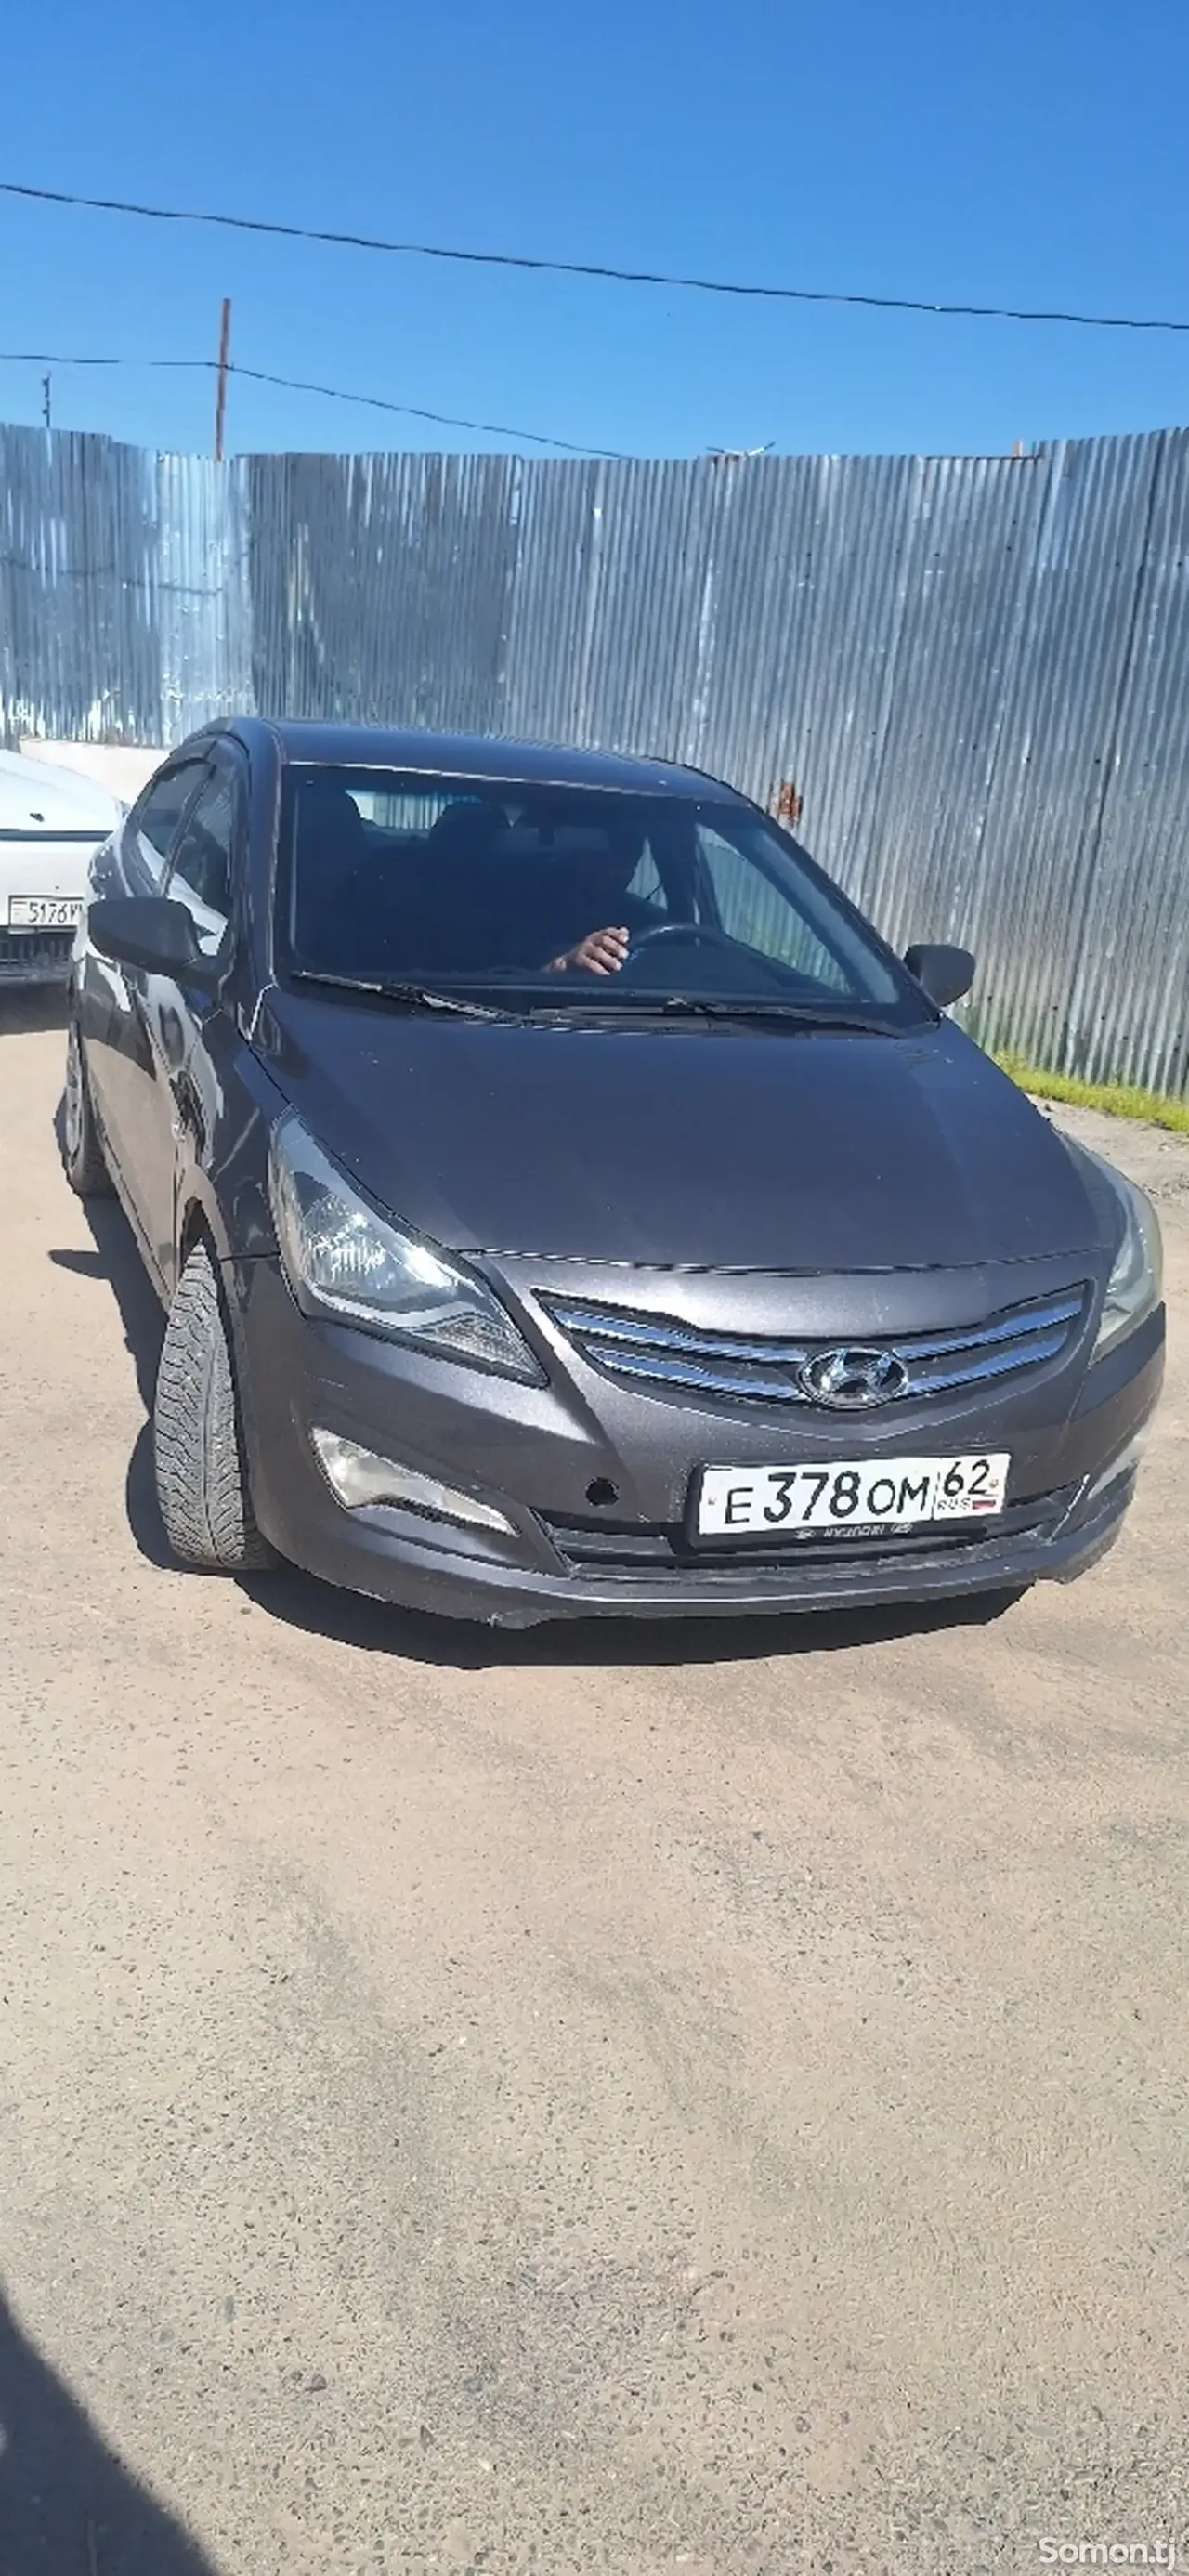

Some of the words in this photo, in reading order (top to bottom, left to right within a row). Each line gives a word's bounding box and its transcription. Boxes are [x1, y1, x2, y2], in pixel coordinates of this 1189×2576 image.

[725, 1471, 930, 1524] E378OM
[943, 1459, 990, 1497] 62
[937, 1497, 971, 1510] RUS
